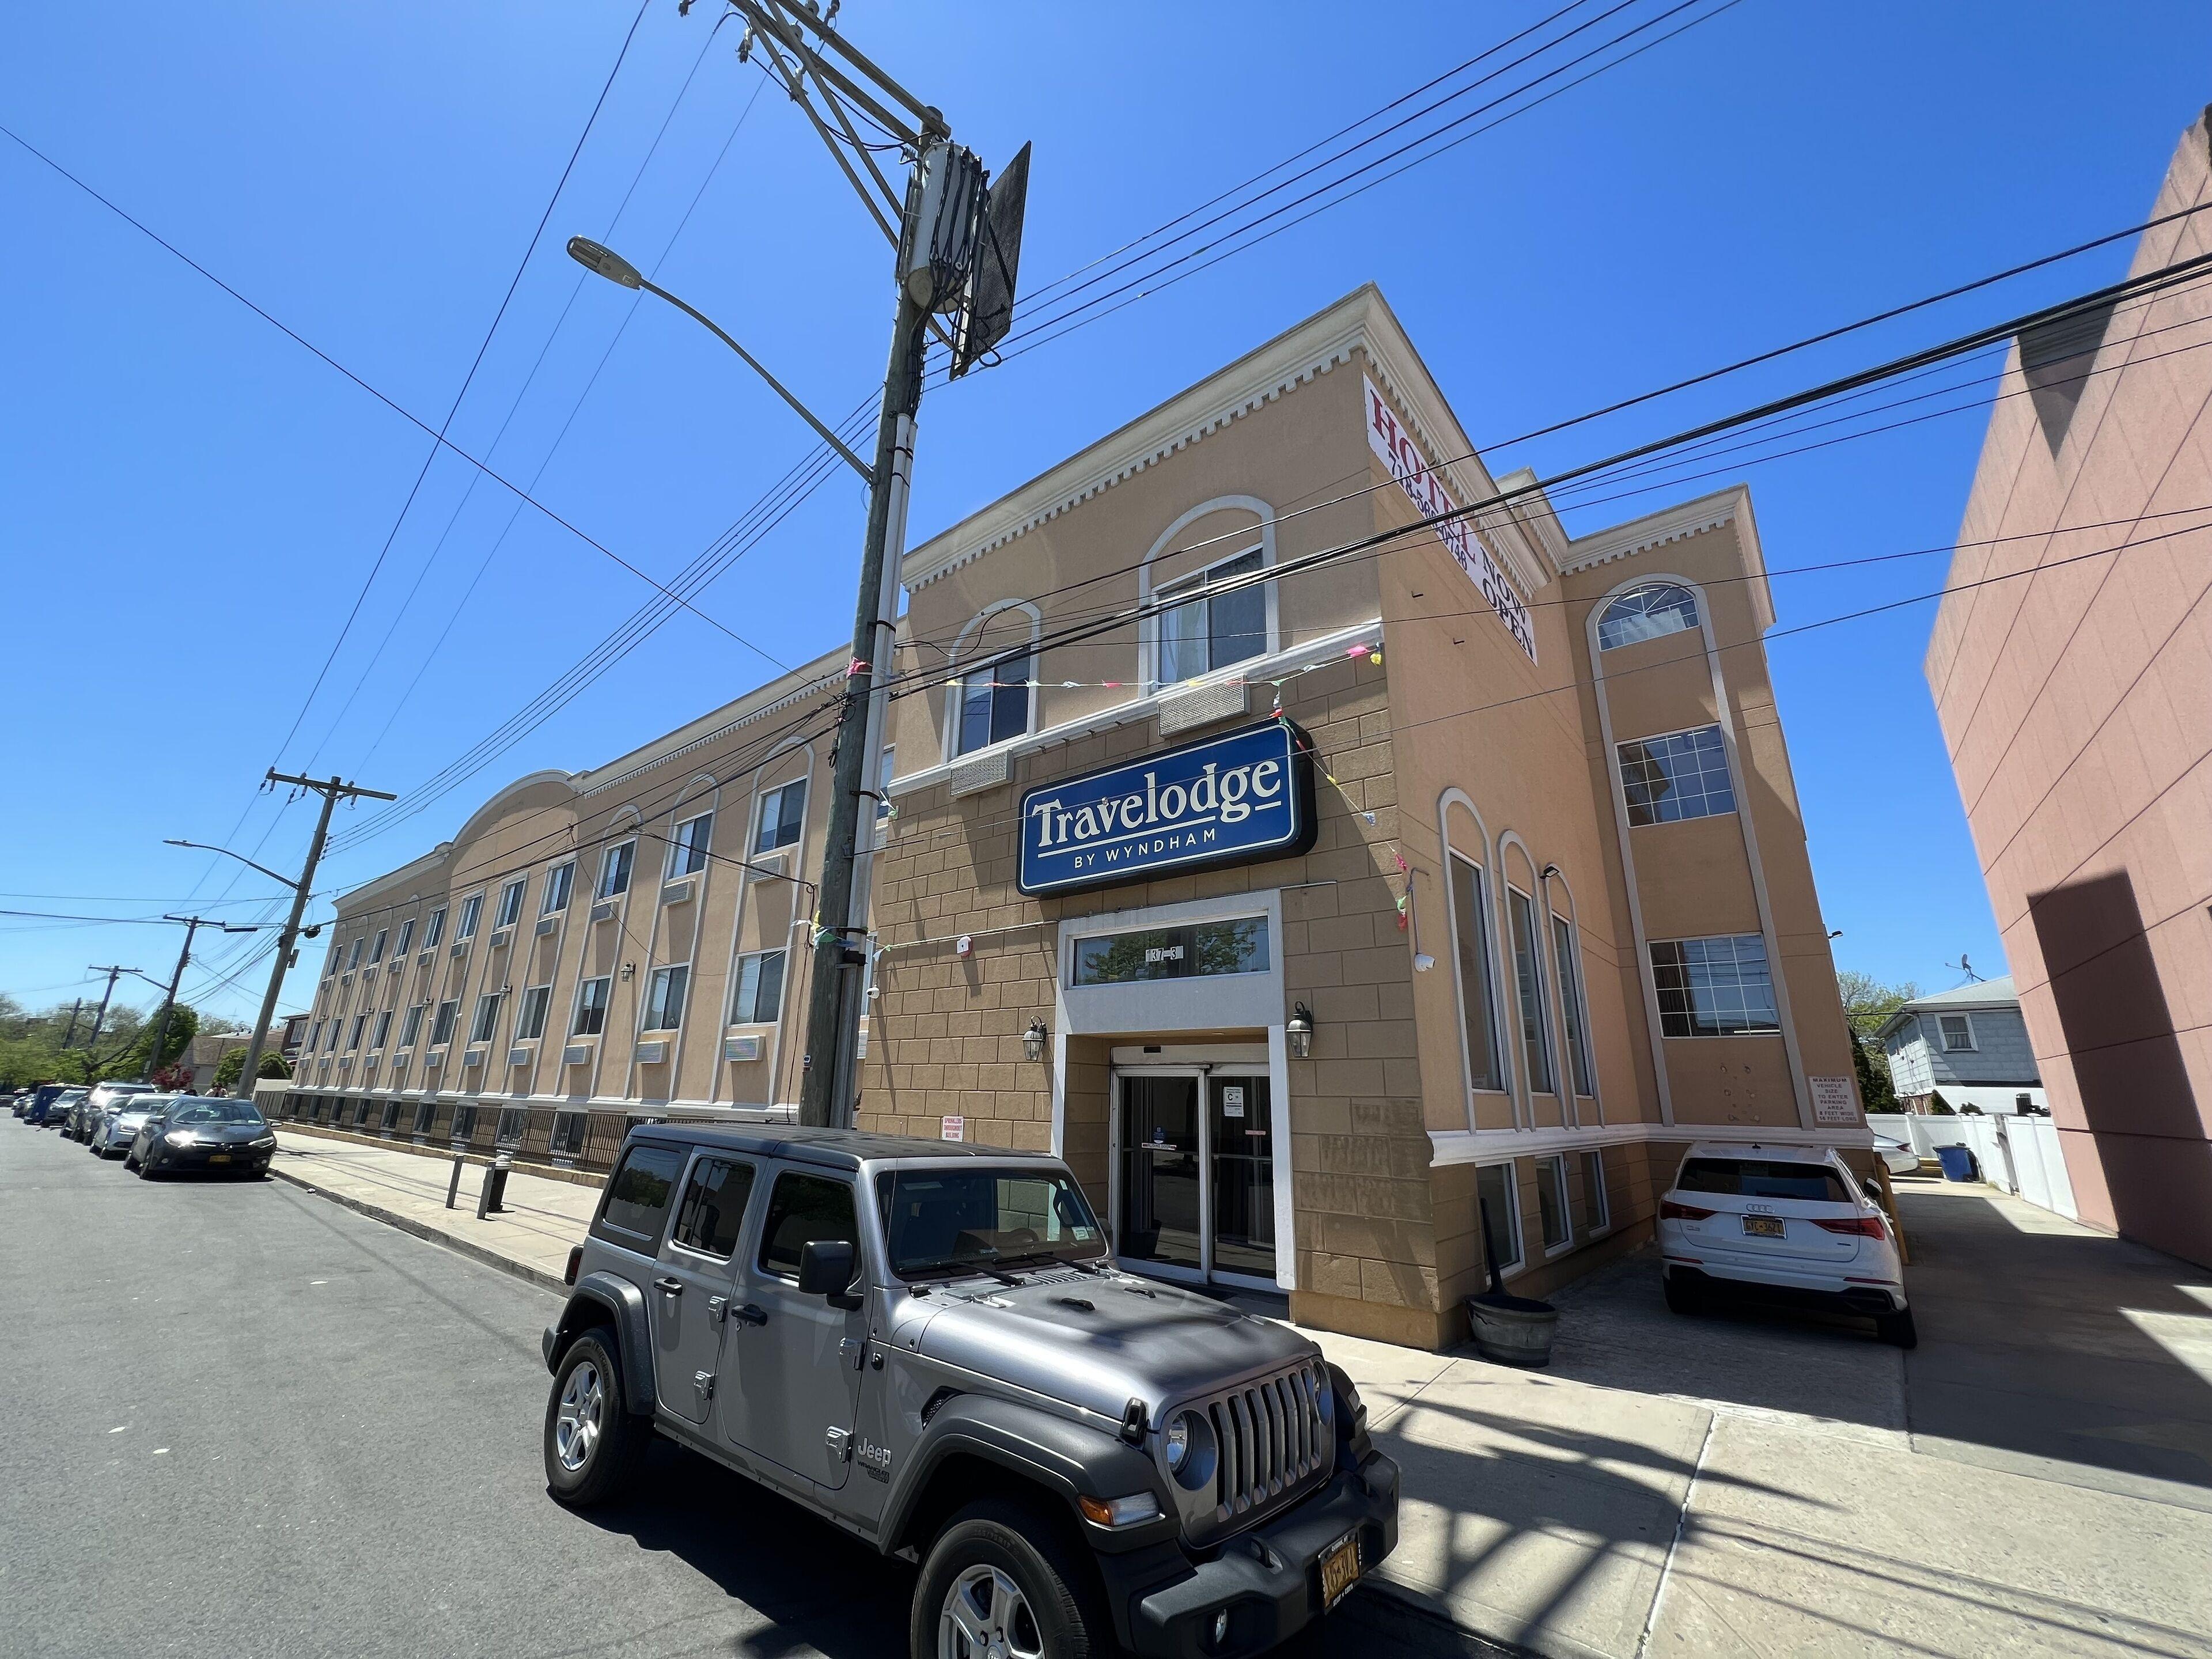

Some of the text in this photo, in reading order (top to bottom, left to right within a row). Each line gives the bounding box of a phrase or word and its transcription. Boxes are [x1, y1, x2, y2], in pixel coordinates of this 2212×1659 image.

[1480, 547, 1526, 625] NOW
[1482, 578, 1534, 661] OPEN
[1032, 760, 1282, 847] Travelodge
[1074, 828, 1217, 869] BY WYNDHAM
[858, 1437, 891, 1467] Jeep
